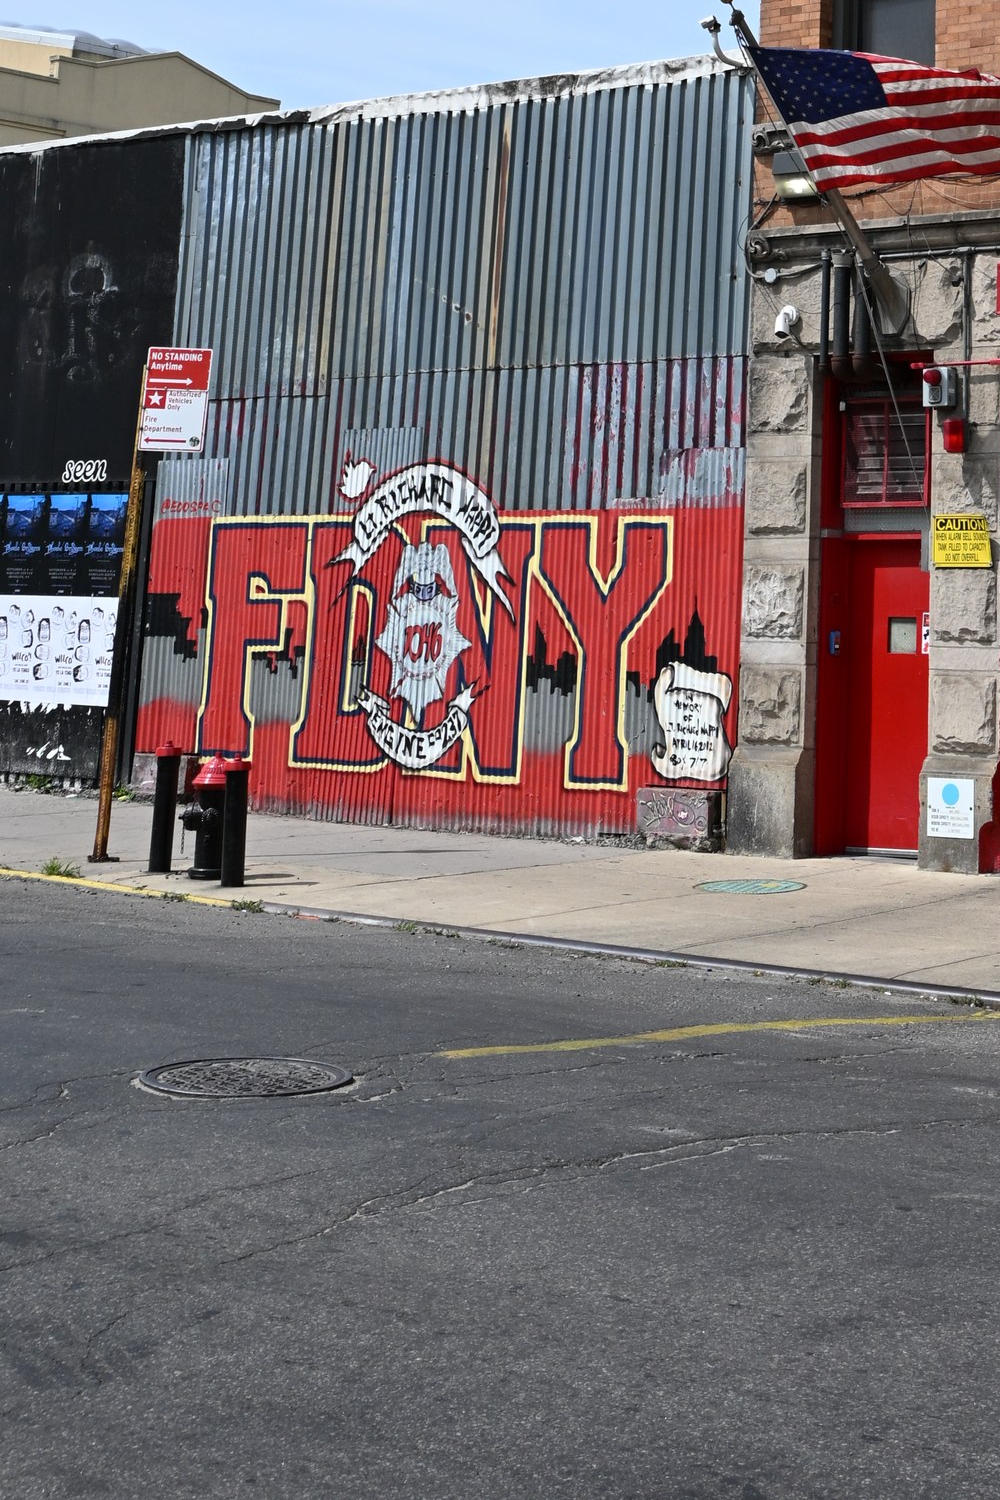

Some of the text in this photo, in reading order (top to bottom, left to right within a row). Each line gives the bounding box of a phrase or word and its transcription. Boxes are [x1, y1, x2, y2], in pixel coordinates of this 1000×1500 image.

[151, 352, 203, 362] NO STANDING
[151, 362, 183, 371] Anytime
[144, 425, 182, 433] Department
[62, 459, 107, 483] seen
[937, 519, 985, 531] CAUTION
[973, 533, 987, 541] SOUNDS
[938, 543, 986, 551] TANK FILLED TO CAPACITY
[195, 515, 674, 792] FDNY
[683, 714, 693, 722] OF
[372, 712, 426, 759] ENGINE
[442, 709, 462, 749] 237
